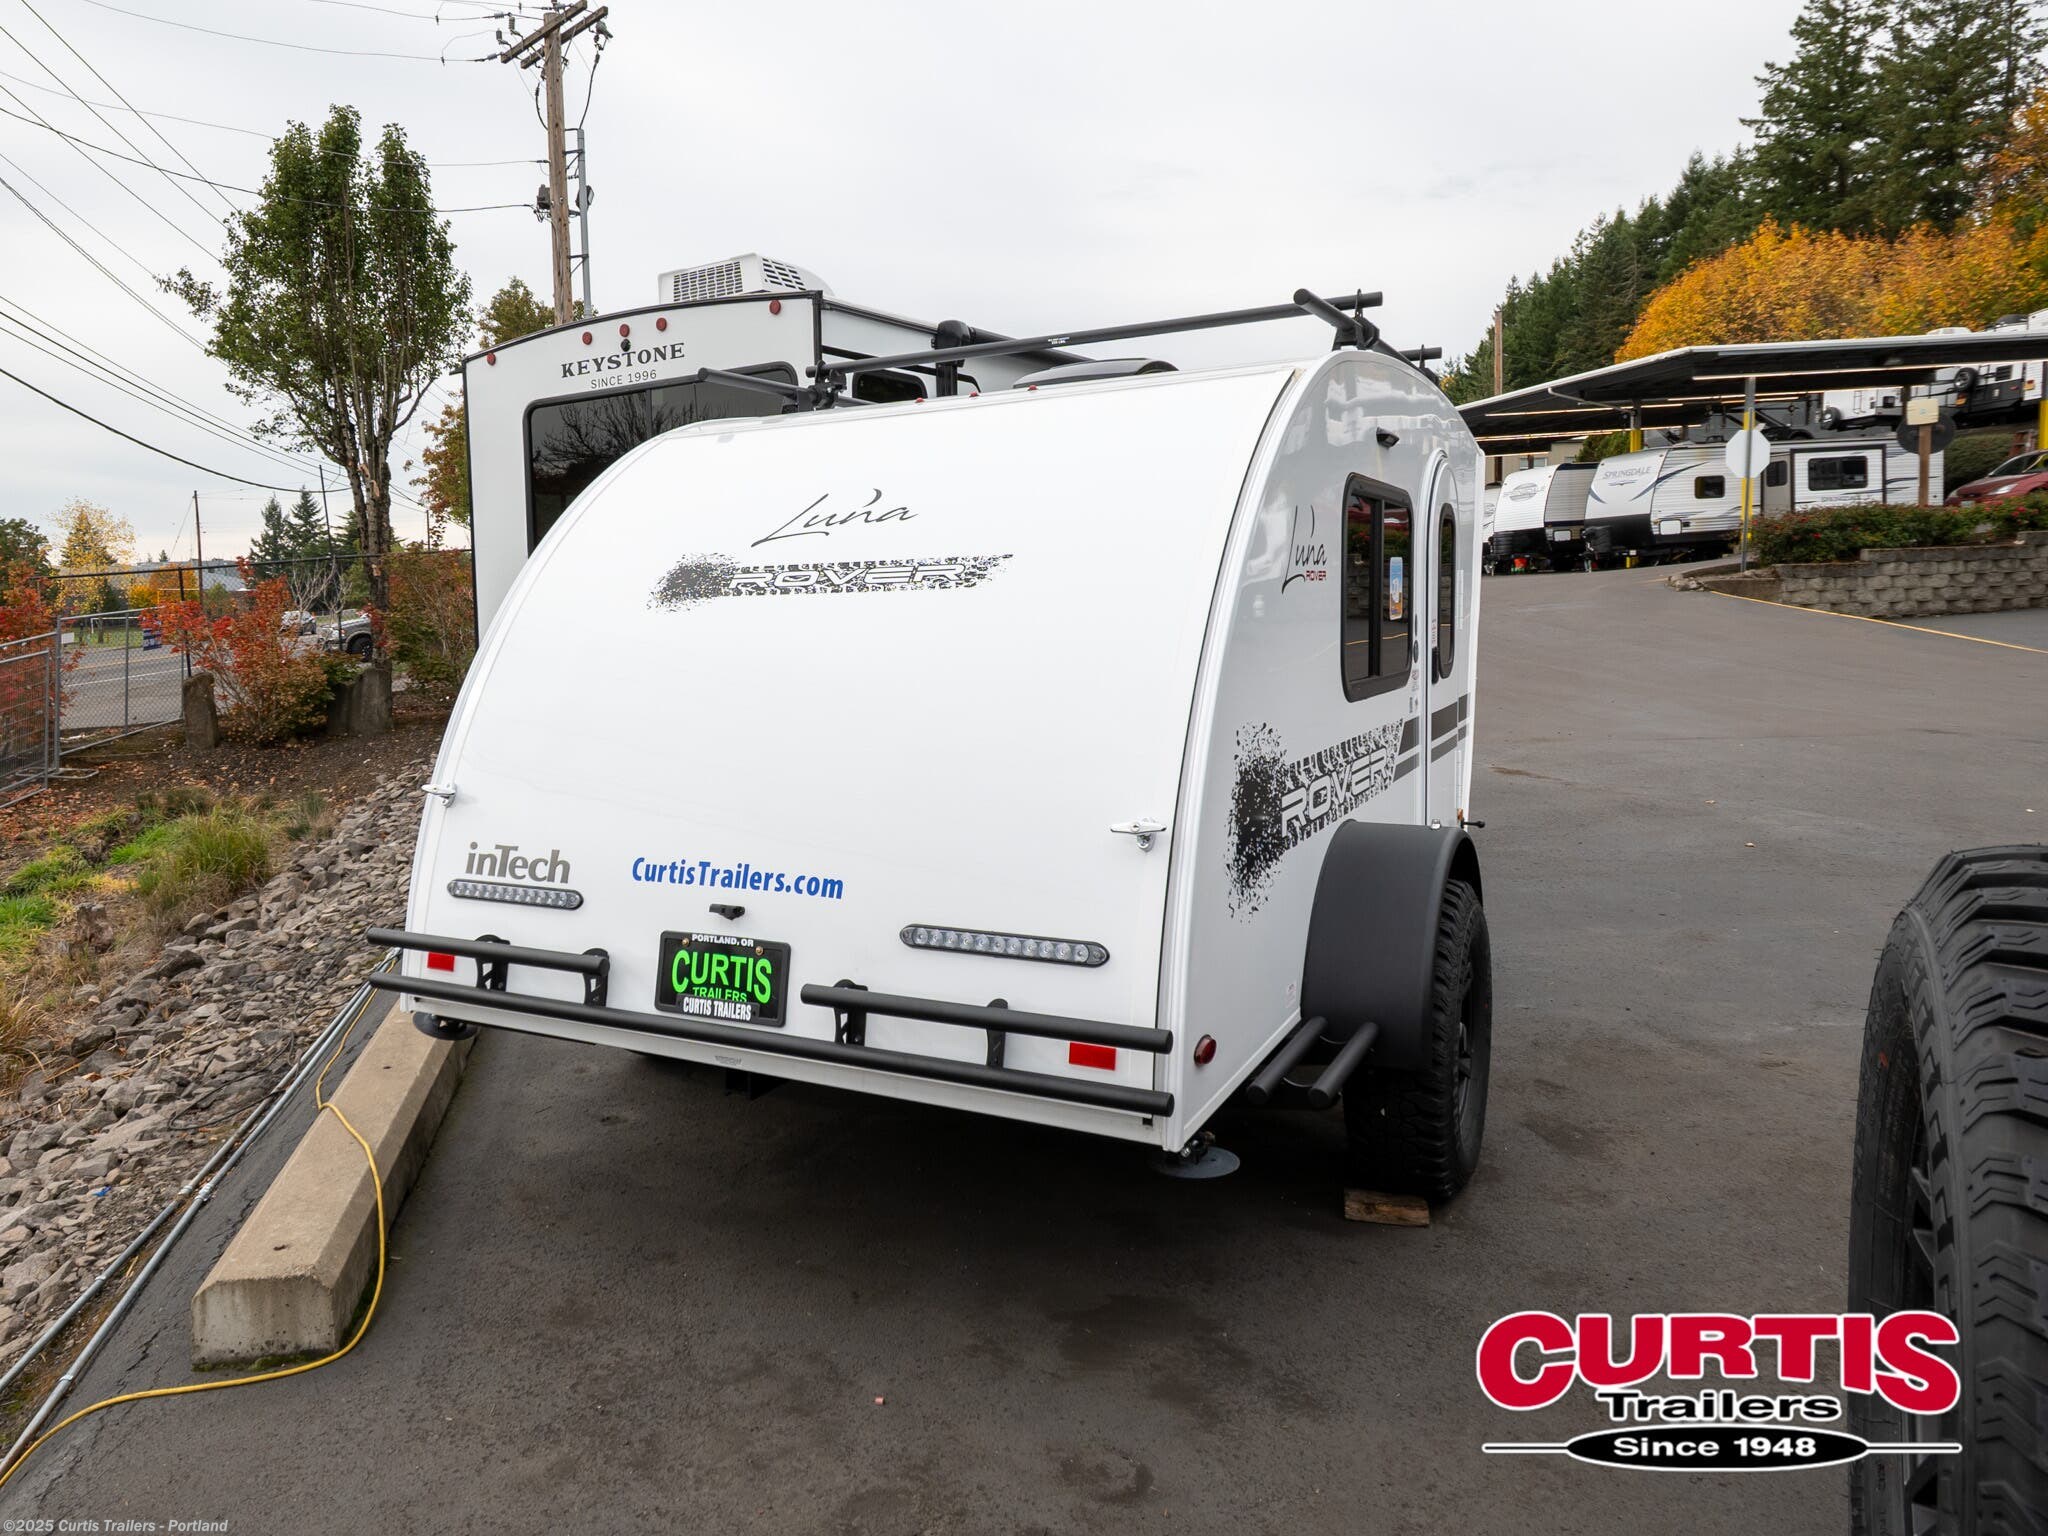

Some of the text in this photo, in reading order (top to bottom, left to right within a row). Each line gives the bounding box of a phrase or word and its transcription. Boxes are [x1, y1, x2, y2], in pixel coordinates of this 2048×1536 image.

[561, 342, 685, 378] KEYSTONE
[591, 369, 657, 389] SINCE 1996
[727, 564, 967, 588] ROVER
[1305, 570, 1327, 582] ROVER
[1281, 747, 1387, 838] ROVER
[465, 841, 571, 884] inTech
[632, 857, 844, 900] CurtisTrailers.com
[691, 933, 754, 947] PORTLAND, OR
[671, 949, 772, 1004] CURTIS
[683, 996, 752, 1021] CURTIS TRAILERS
